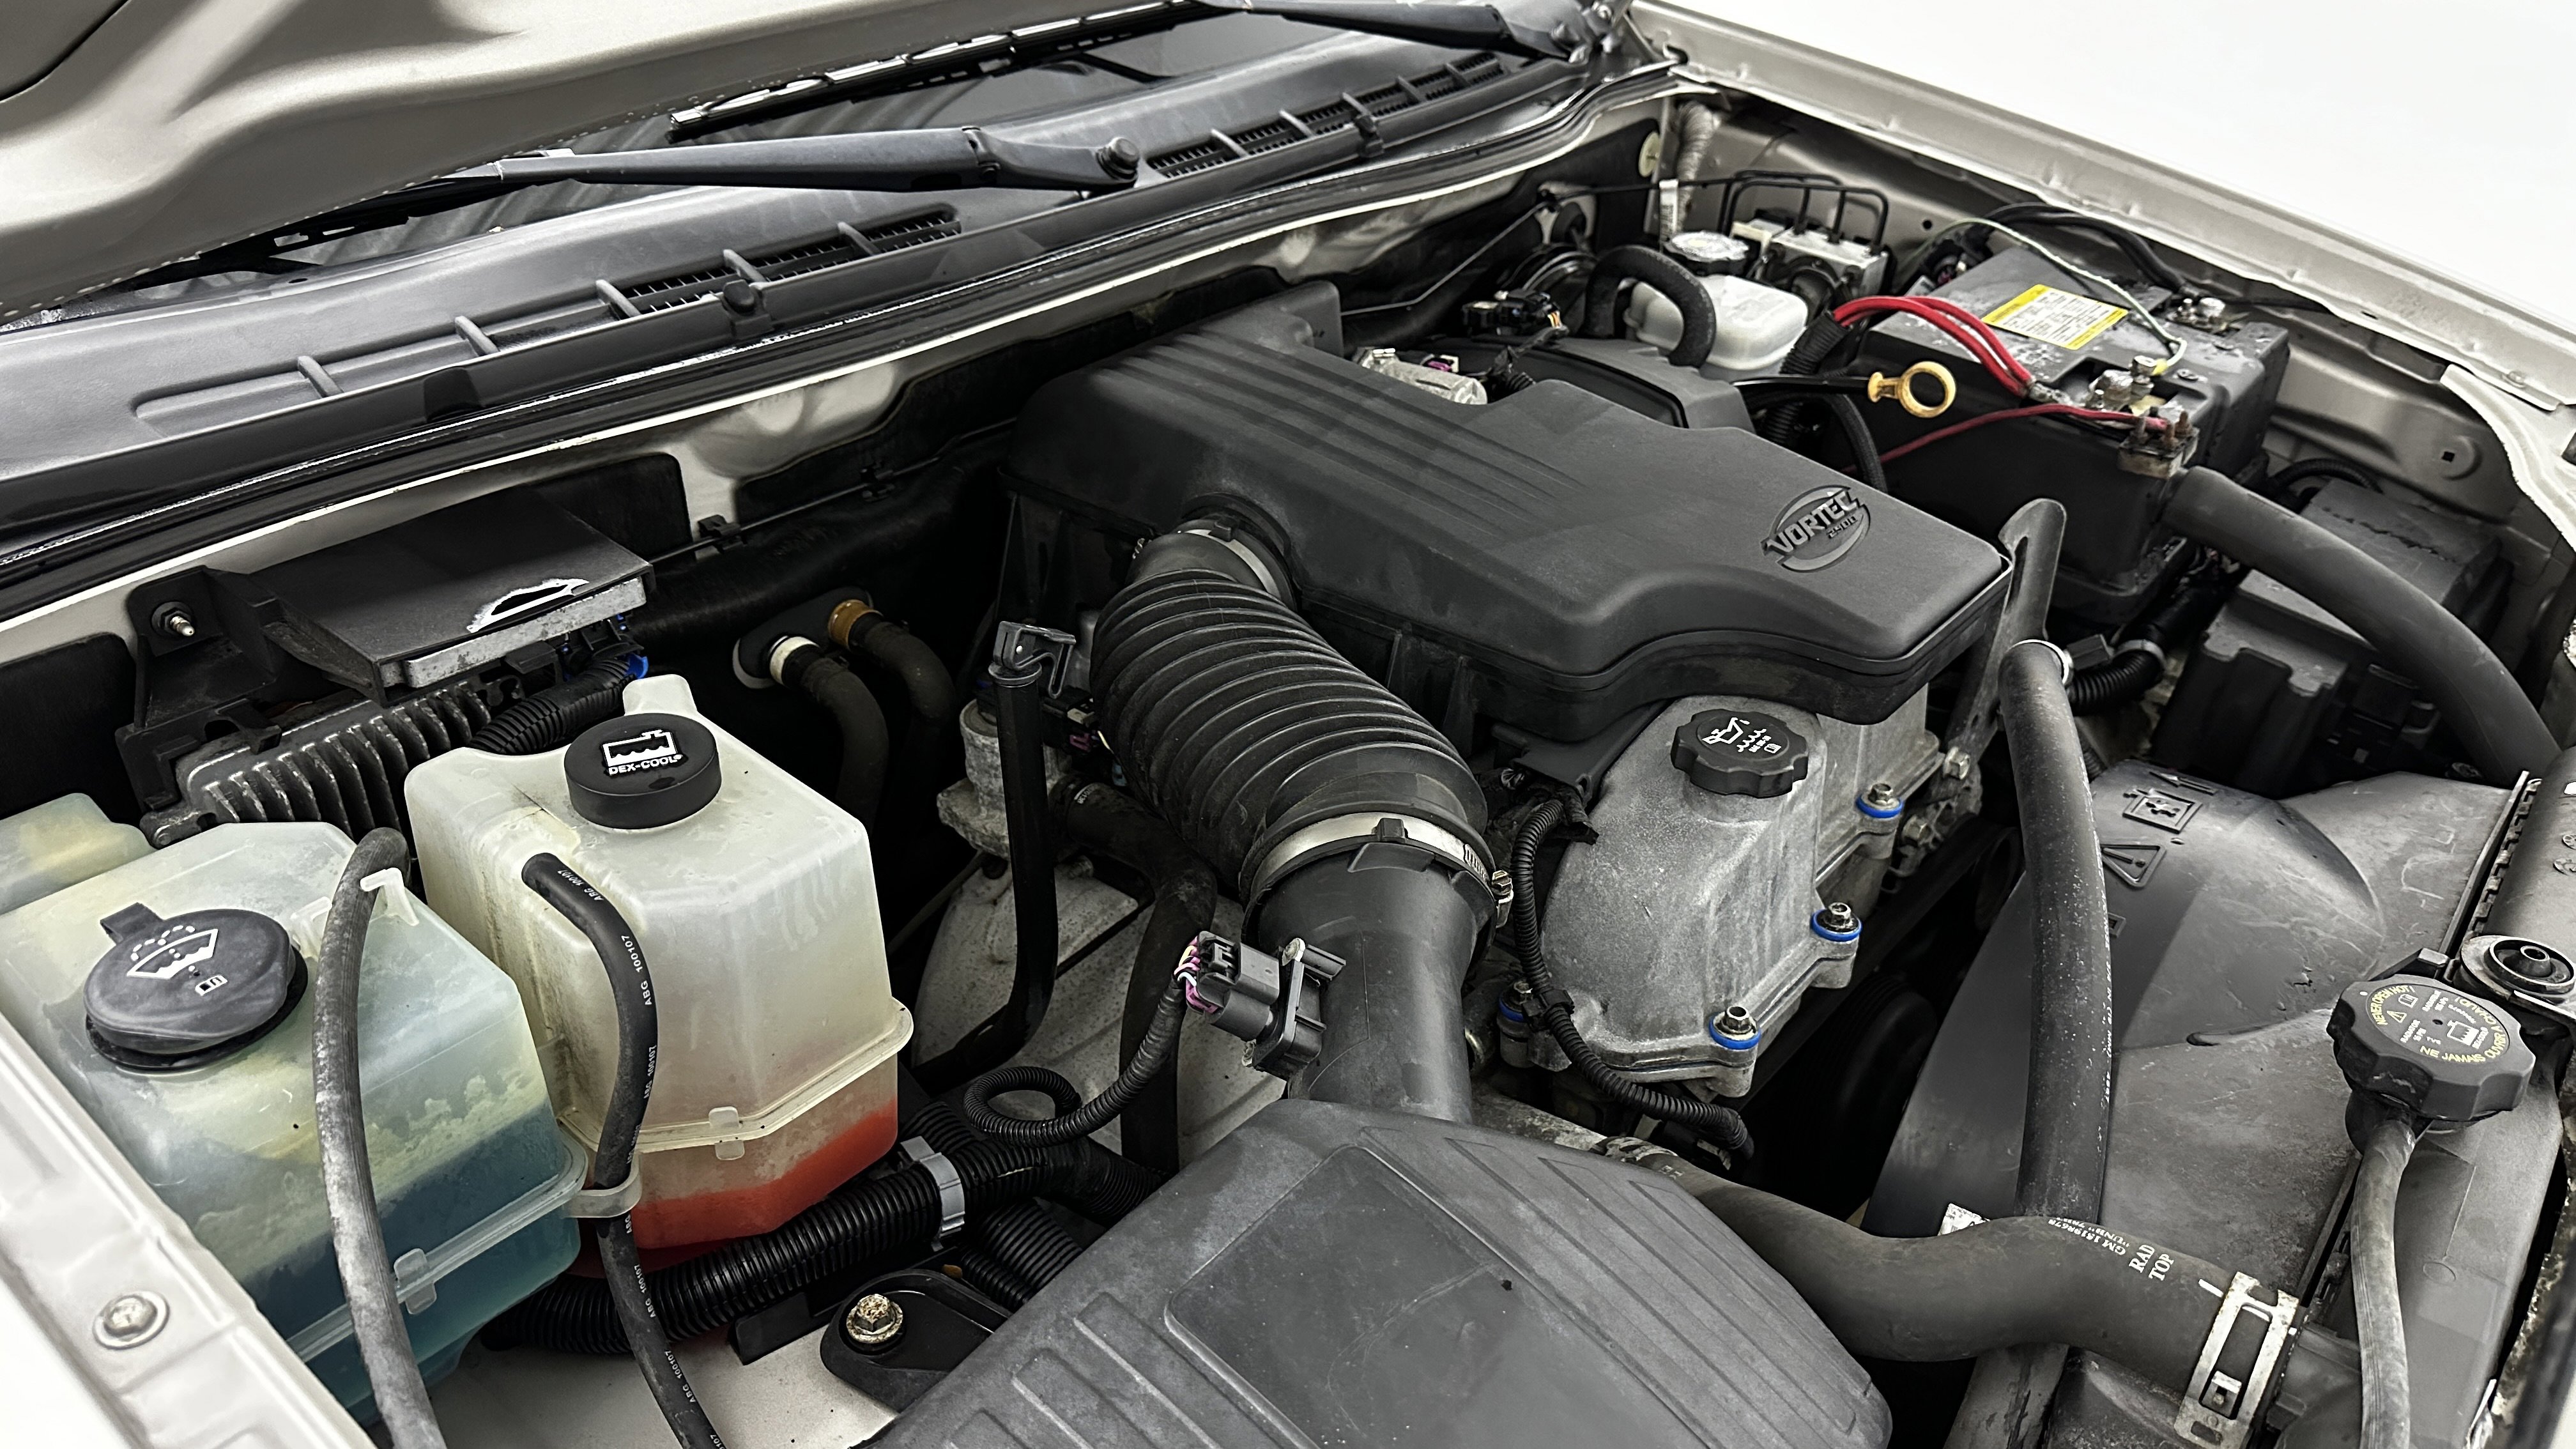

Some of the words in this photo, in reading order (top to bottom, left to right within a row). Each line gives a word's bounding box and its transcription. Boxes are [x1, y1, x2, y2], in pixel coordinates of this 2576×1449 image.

[1767, 490, 1857, 553] VORTEC
[621, 934, 643, 973] 100107
[640, 980, 652, 1006] ABG
[2372, 989, 2394, 1004] OPEN
[2370, 1002, 2389, 1025] NEVER
[2400, 1019, 2421, 1043] RADIATOR
[647, 1045, 657, 1077] 100107
[2419, 1045, 2440, 1058] NE
[2441, 1052, 2486, 1062] JAMAIS
[643, 1080, 652, 1099] ABG
[2102, 1239, 2126, 1256] GM
[2129, 1244, 2156, 1273] RAD
[634, 1264, 647, 1294] 100107
[2148, 1254, 2175, 1281] TOP
[645, 1298, 656, 1318] ABG
[664, 1349, 683, 1379] 100107
[682, 1384, 696, 1404] ABG
